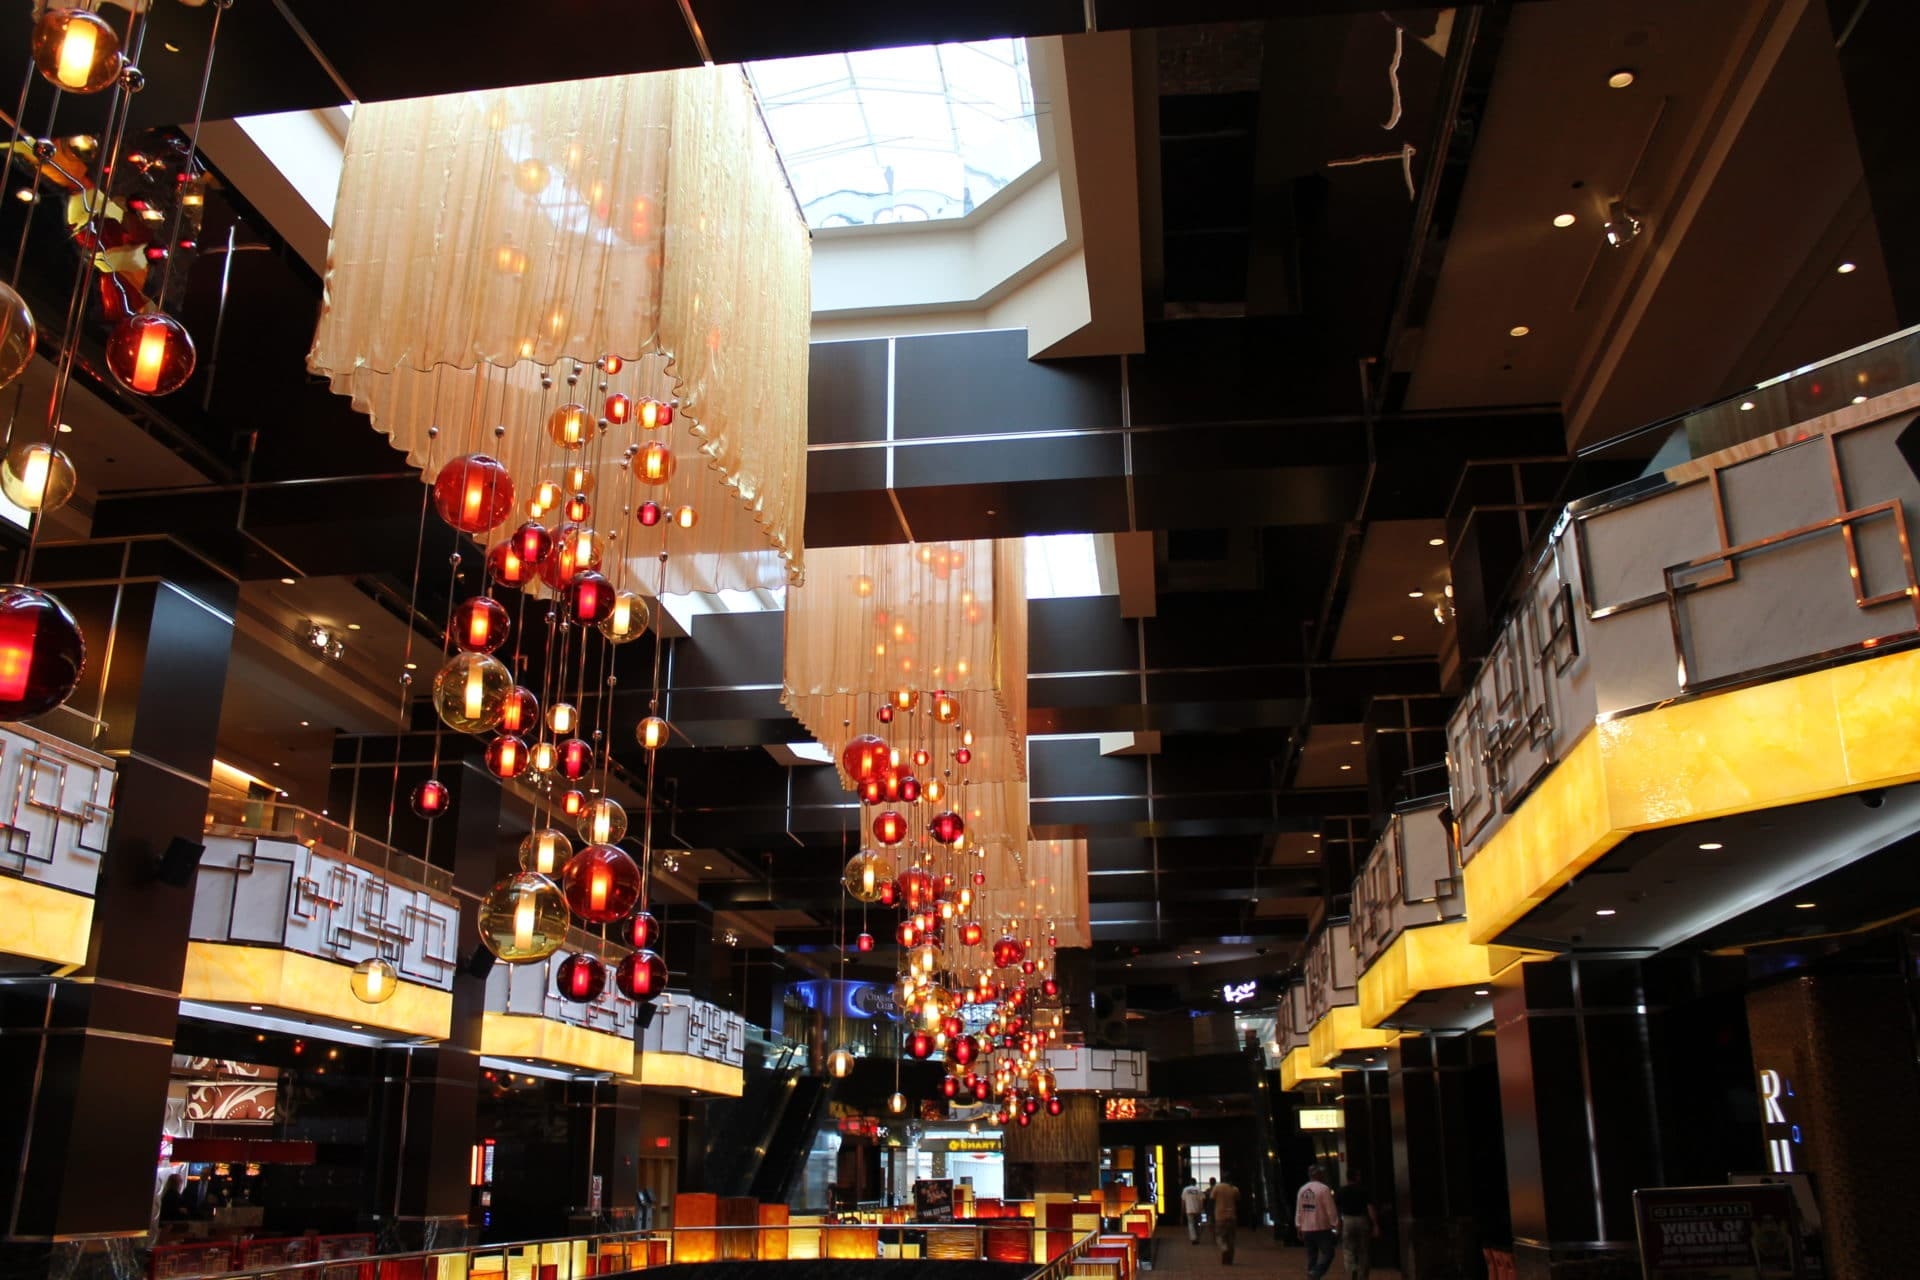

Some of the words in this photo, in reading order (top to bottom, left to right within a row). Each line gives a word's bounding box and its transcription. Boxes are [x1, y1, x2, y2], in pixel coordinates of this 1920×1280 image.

[1660, 1220, 1716, 1234] WHEEL
[1721, 1218, 1744, 1232] OF
[1663, 1231, 1742, 1245] FORTUNE
